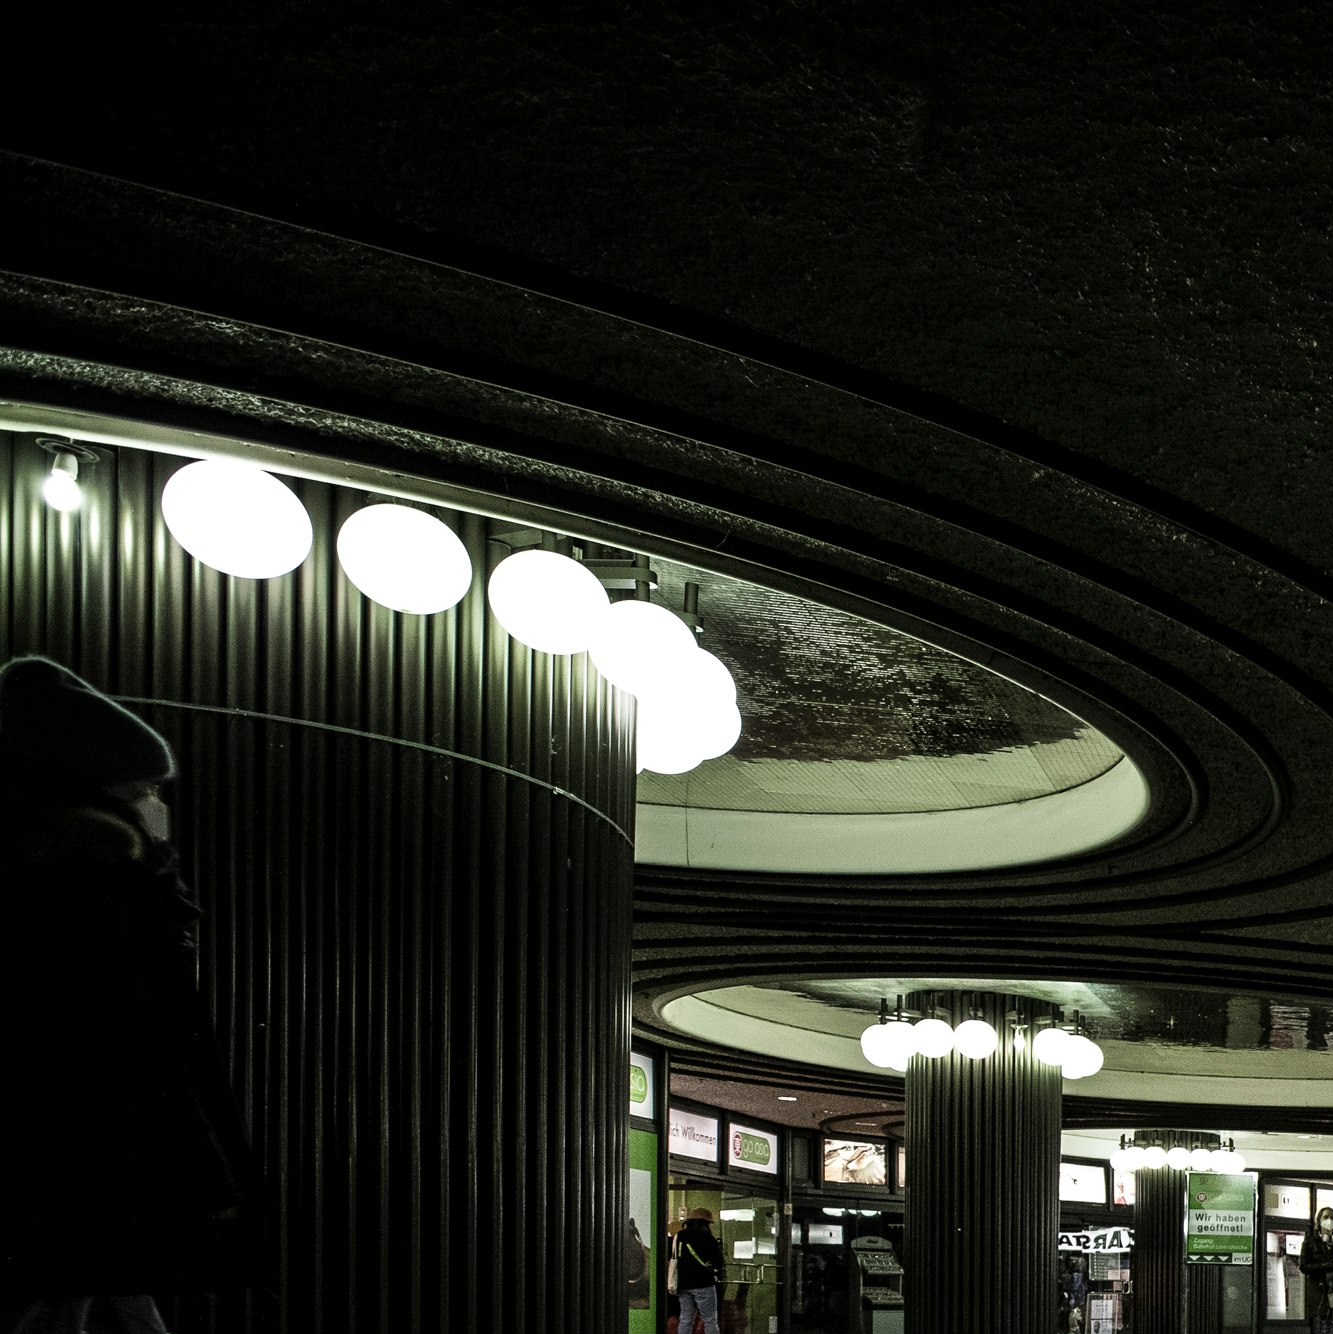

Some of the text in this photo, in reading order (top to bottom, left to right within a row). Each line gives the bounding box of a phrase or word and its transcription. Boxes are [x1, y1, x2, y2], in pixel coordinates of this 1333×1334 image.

[680, 1125, 717, 1145] Willkommen
[743, 1139, 769, 1159] go asia
[1195, 1213, 1246, 1222] Wir haben
[1197, 1223, 1244, 1233] geöffnet!
